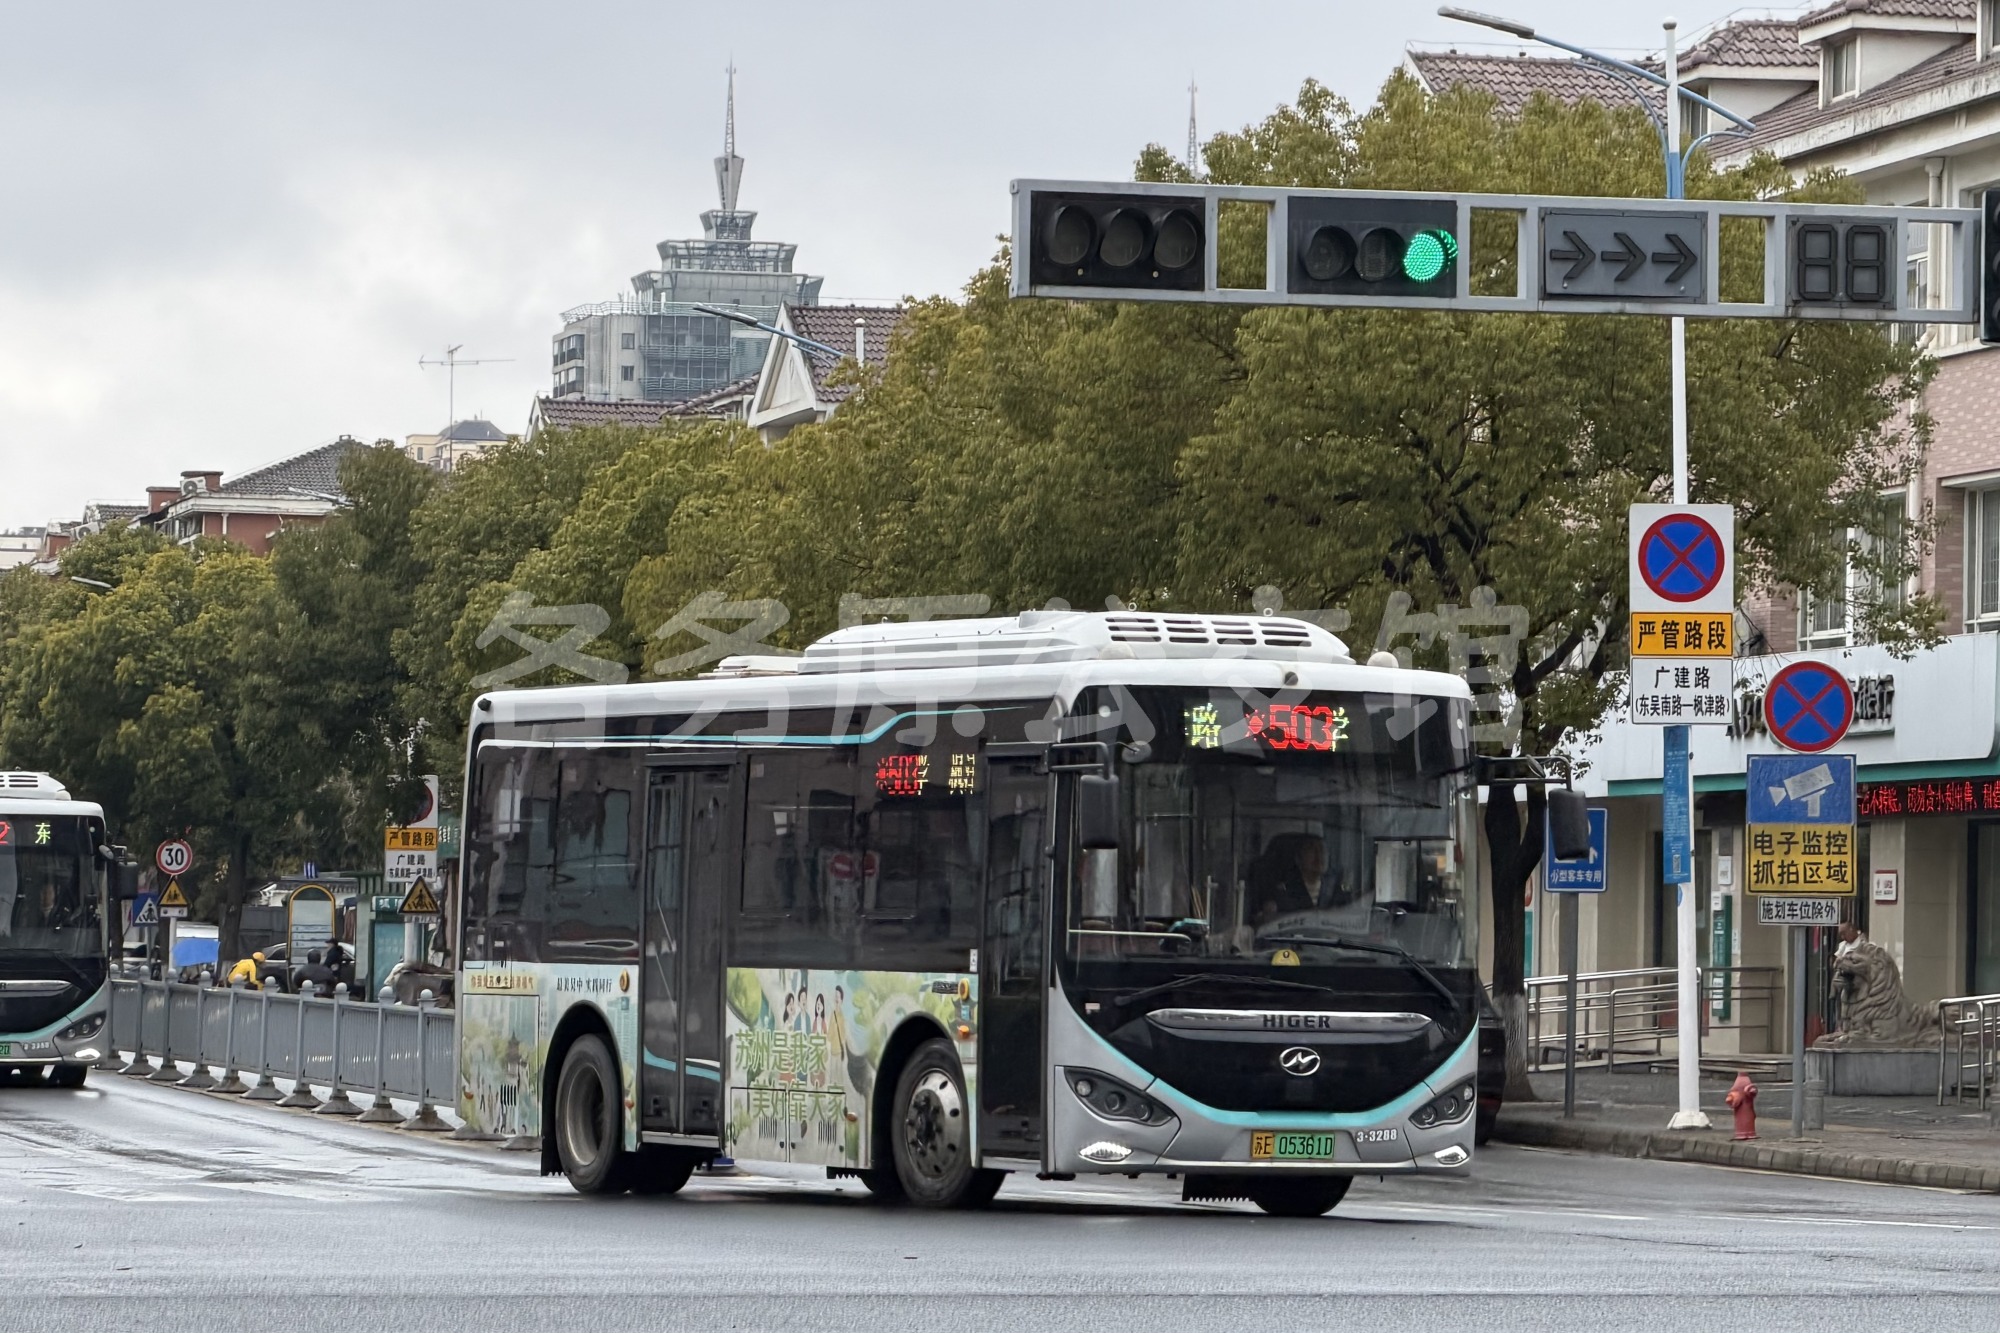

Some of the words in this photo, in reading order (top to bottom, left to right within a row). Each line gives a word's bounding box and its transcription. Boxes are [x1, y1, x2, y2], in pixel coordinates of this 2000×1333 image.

[1637, 620, 1727, 650] 严管路段
[1654, 666, 1711, 689] 广建路
[1269, 705, 1333, 750] 503
[388, 831, 435, 846] 严管路段
[1754, 829, 1848, 855] 电子监控
[165, 848, 185, 866] 30
[397, 854, 426, 865] 广建路
[1753, 860, 1849, 885] 抓拍区域
[1762, 900, 1836, 920] 施划车位除外
[1263, 1014, 1331, 1029] HIGER
[735, 1028, 827, 1073] 苏州是我家
[752, 1079, 846, 1121] 美好靠大家
[1278, 1136, 1334, 1156] 05361D
